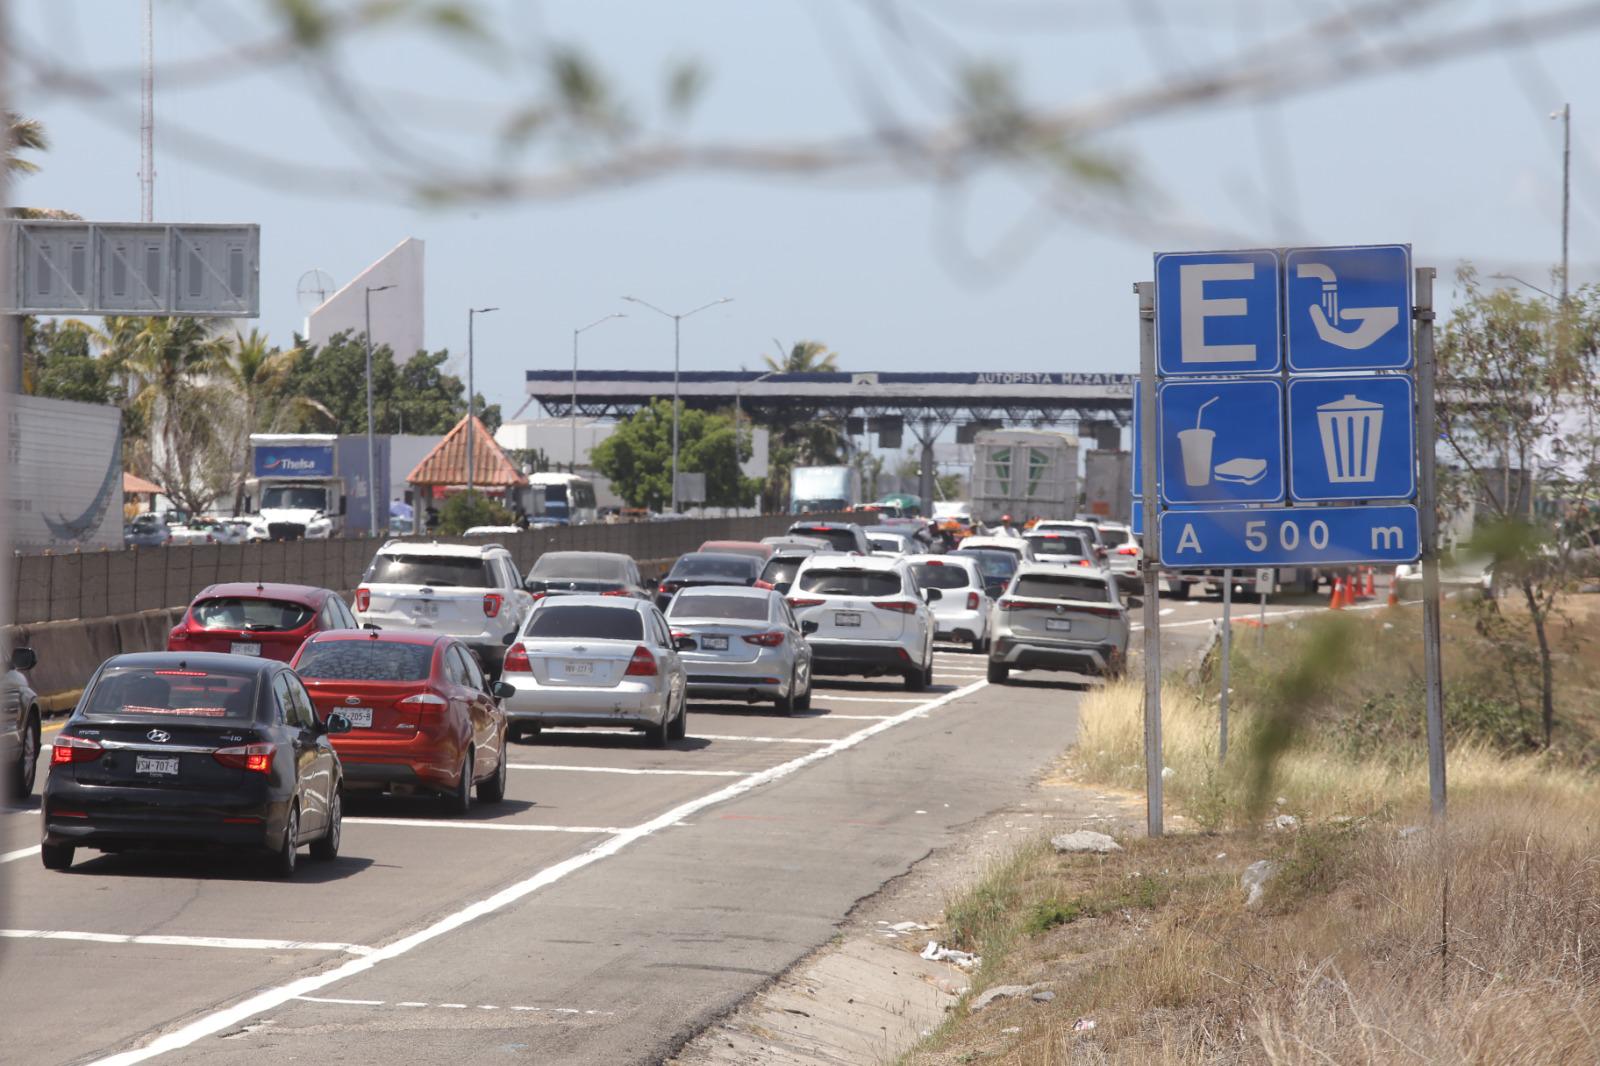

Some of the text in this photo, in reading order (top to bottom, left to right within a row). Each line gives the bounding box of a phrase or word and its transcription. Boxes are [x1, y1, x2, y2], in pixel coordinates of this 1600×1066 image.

[1179, 262, 1256, 363] E
[976, 373, 1052, 384] AUTOPISTA
[281, 458, 316, 470] Thelsa
[1175, 519, 1404, 554] A 500 m
[1261, 571, 1269, 582] 6
